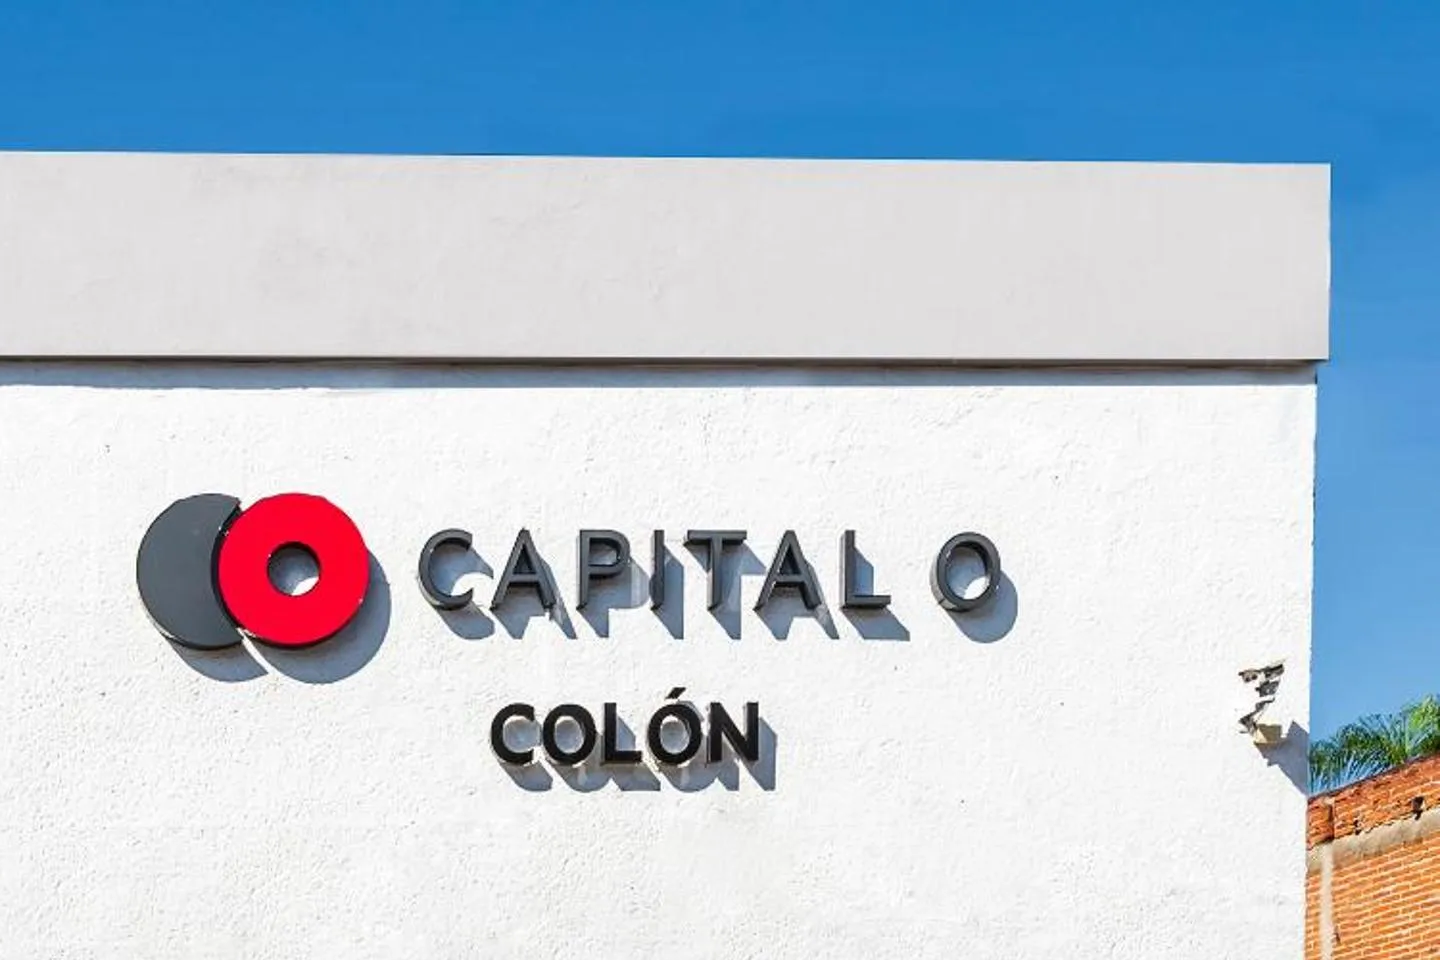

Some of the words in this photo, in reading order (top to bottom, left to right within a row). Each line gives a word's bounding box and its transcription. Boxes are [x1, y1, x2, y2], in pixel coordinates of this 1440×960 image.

[418, 527, 893, 614] CAPITAL
[934, 531, 1002, 612] O
[490, 687, 761, 766] COLÓN
